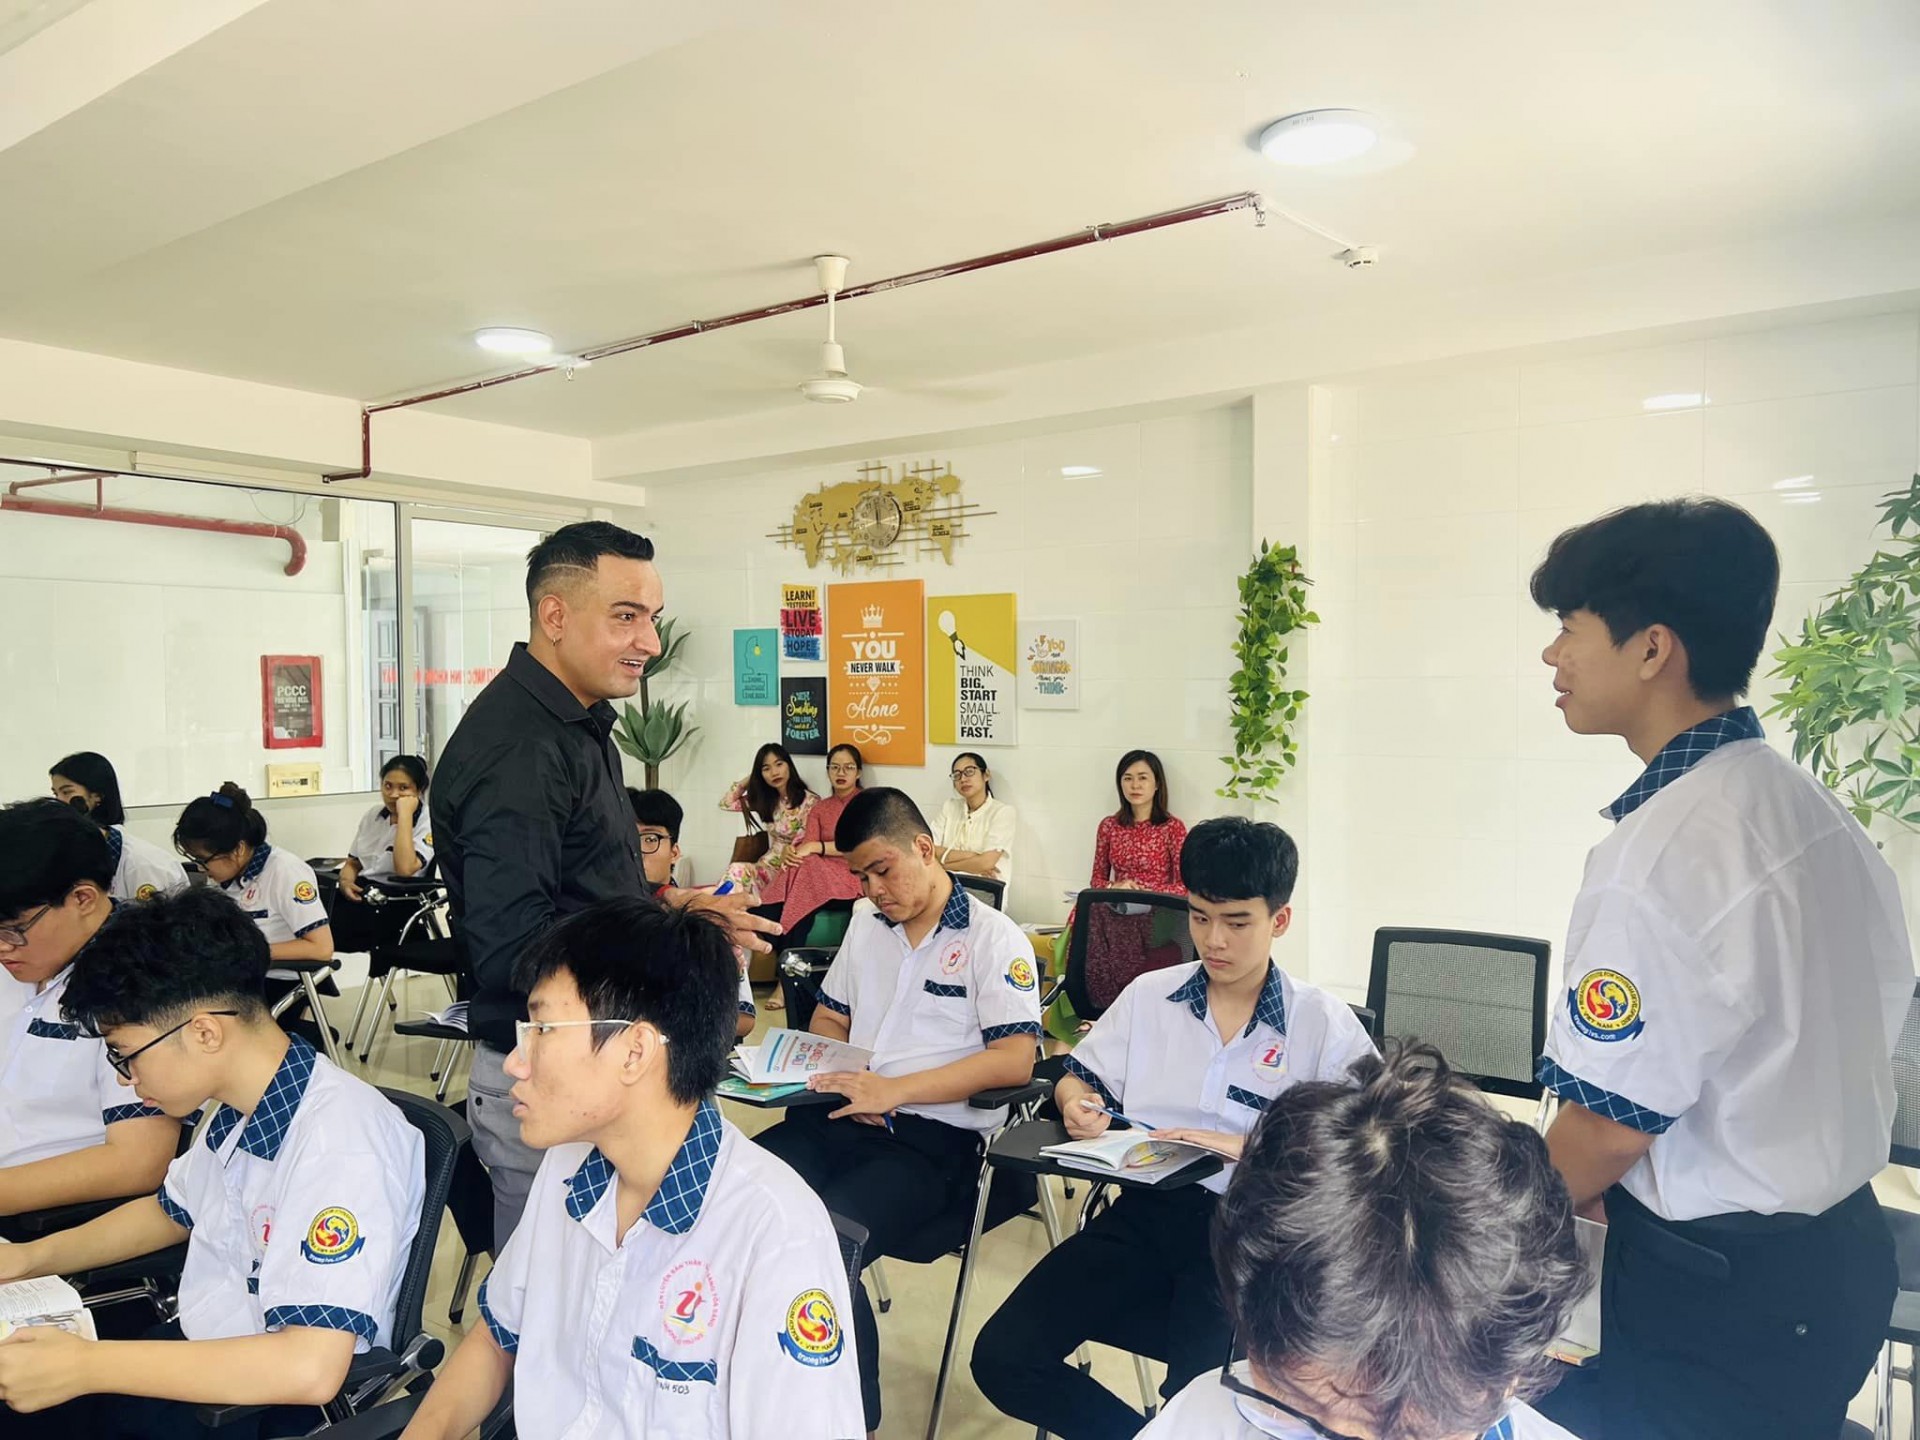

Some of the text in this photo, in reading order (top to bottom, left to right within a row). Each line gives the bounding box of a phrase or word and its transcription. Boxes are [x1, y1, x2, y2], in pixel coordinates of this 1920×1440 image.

[786, 601, 815, 609] YESTERDAY
[785, 609, 816, 627] LIVE
[786, 640, 811, 652] HOPE
[851, 640, 896, 660] YOU
[850, 661, 896, 673] NEVER WALK
[960, 665, 994, 677] THINK
[960, 677, 985, 689] BIG.
[277, 685, 307, 697] PCCC
[960, 689, 998, 701] START
[846, 692, 900, 720] Alone
[960, 702, 1001, 715] SMALL.
[960, 714, 993, 727] MOVE
[785, 727, 821, 741] FOREVER
[960, 726, 993, 739] FAST.
[672, 1384, 690, 1395] 503
